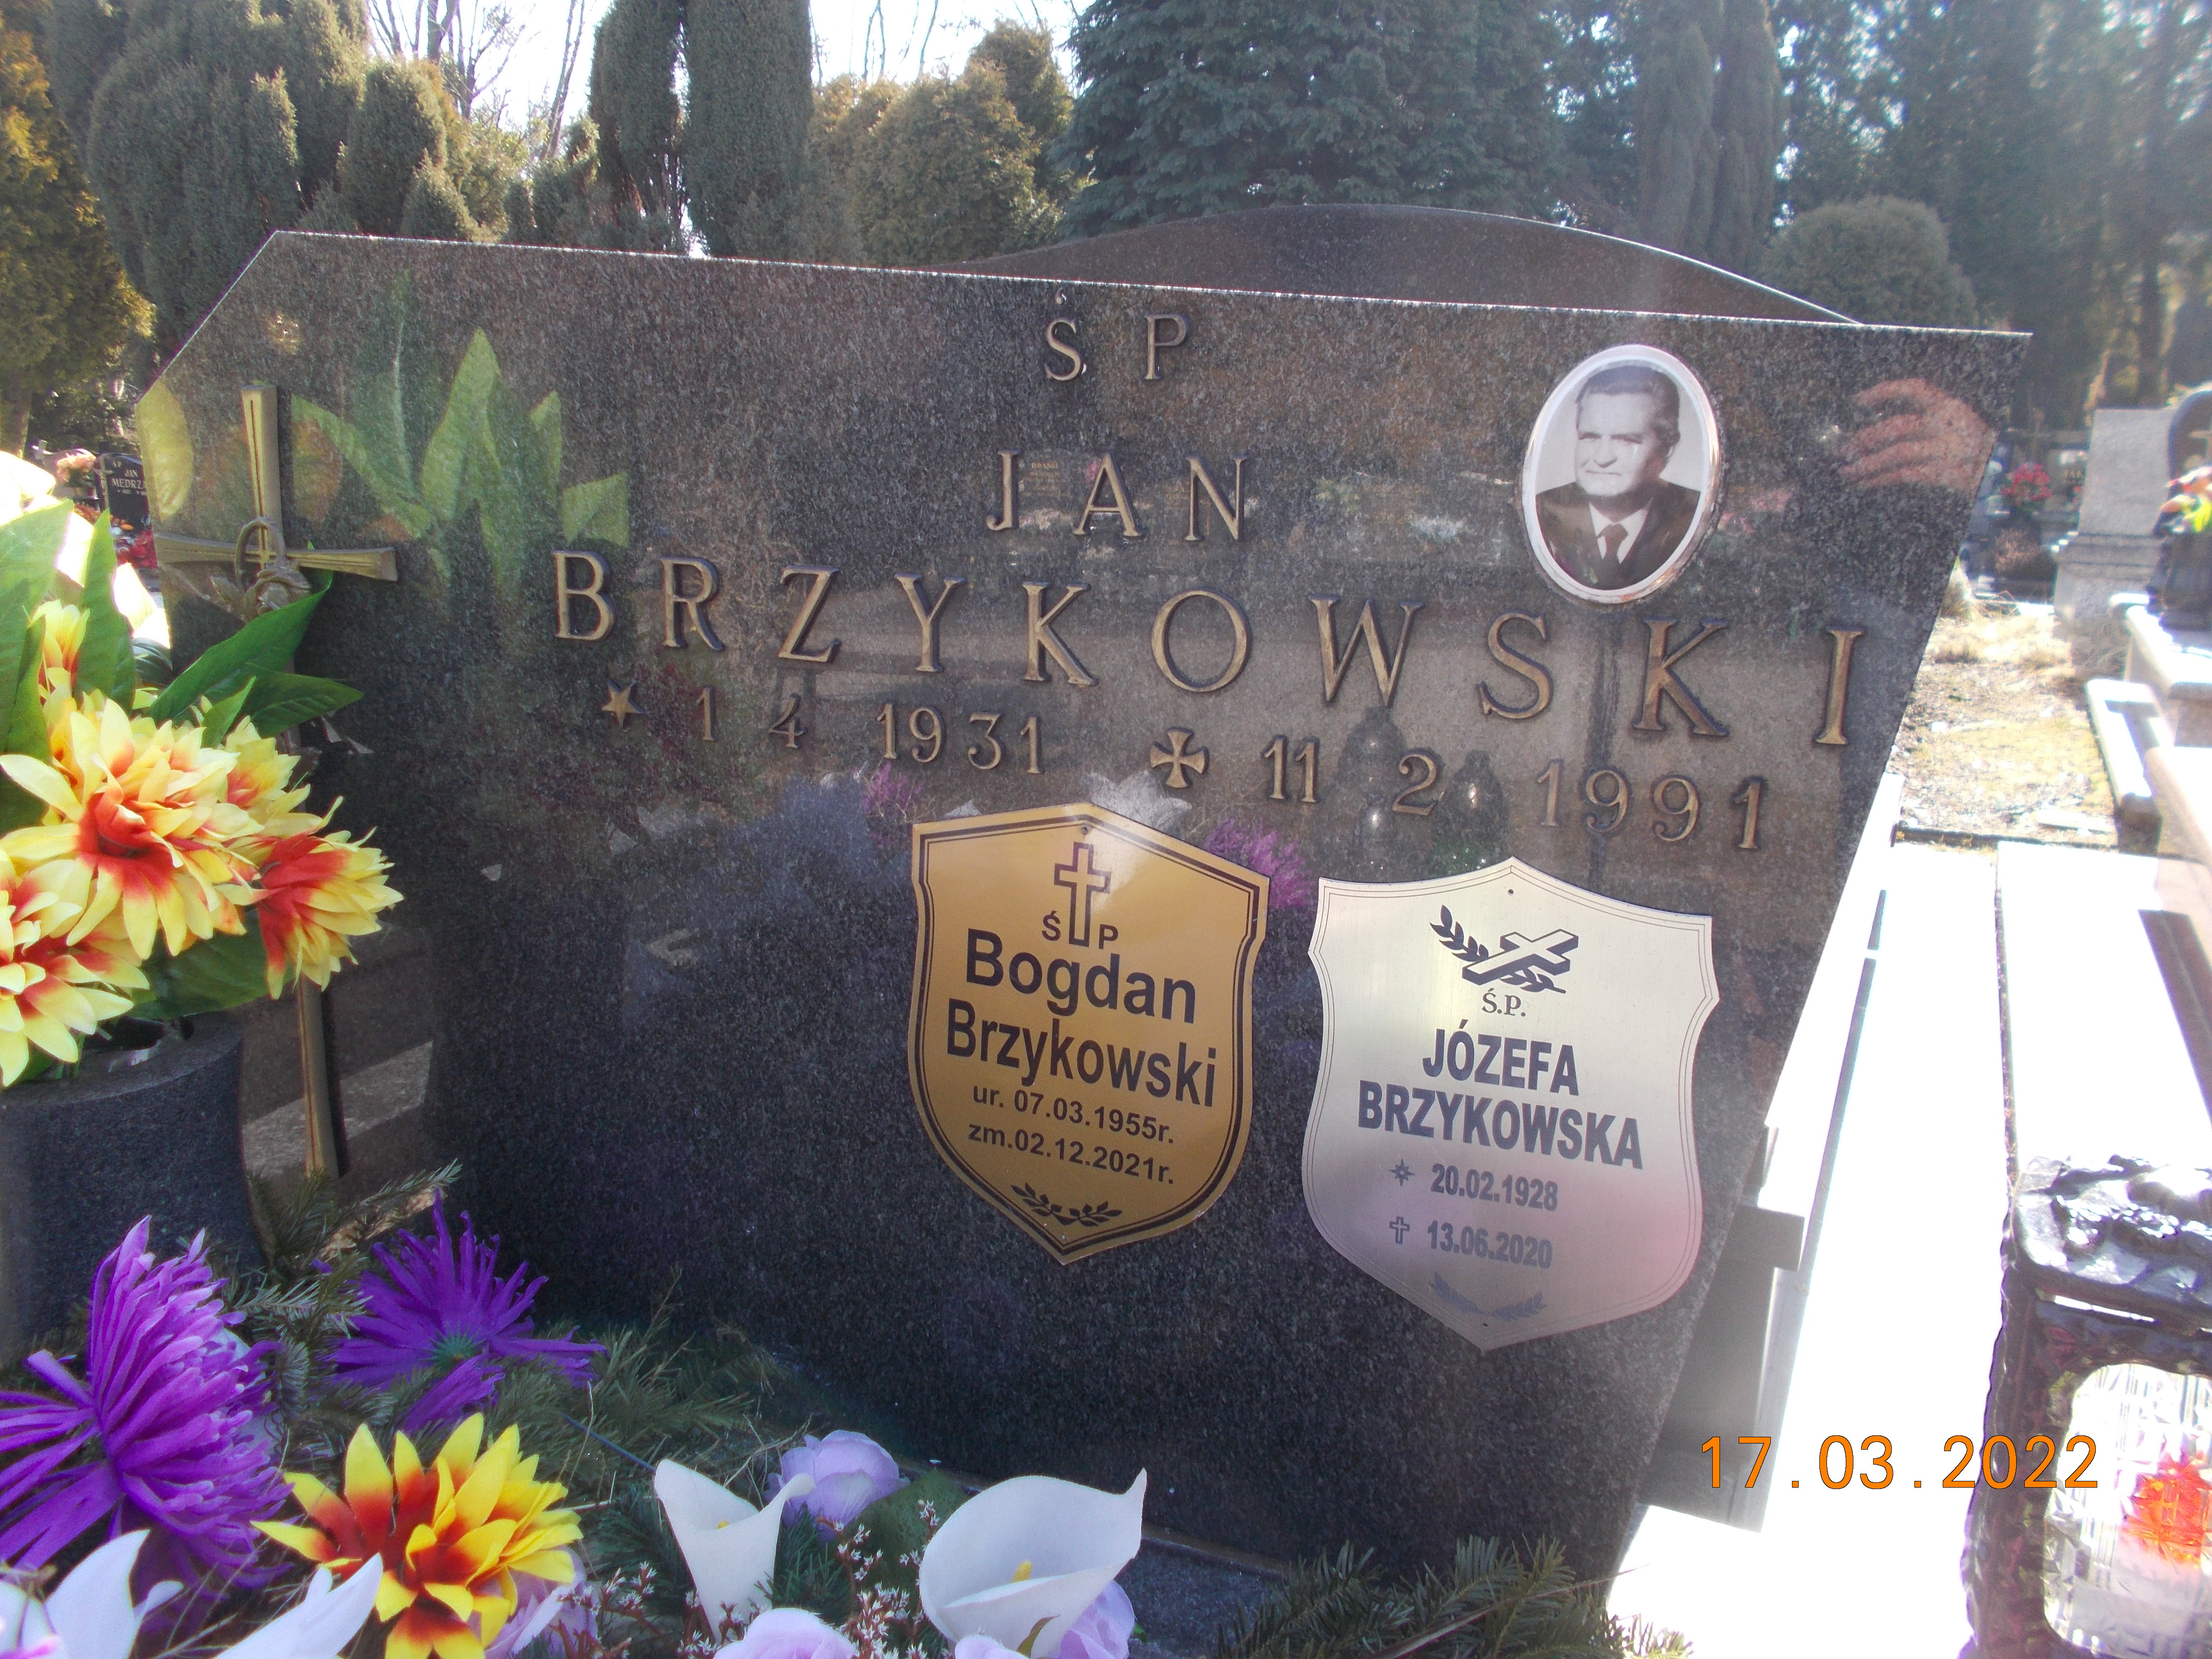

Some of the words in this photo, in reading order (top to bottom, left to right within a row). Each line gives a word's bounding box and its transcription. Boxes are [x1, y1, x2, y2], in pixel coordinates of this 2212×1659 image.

[1143, 313, 1189, 380] P
[986, 449, 1248, 541] JAN
[551, 550, 1865, 746] BRZYKOWSKI
[696, 685, 716, 742] 1
[770, 693, 808, 748] 4
[877, 703, 1045, 775] 1931
[1262, 734, 1320, 805] 11
[1392, 751, 1439, 817] 2
[1537, 758, 1765, 851] 1991
[1041, 911, 1061, 941] Ś
[1099, 923, 1118, 950] P
[966, 927, 1197, 1024] Bogdan
[1481, 987, 1527, 1017] Ś.P.
[947, 998, 1216, 1107] Brzykowski
[1422, 1019, 1579, 1096] JÓZEFA
[973, 1085, 1004, 1107] ur.
[1013, 1089, 1174, 1144] 07.03.1955r.
[1358, 1080, 1643, 1169] BRZYKOWSKA
[968, 1123, 1174, 1185] zm.02.12.2021r.
[1431, 1163, 1559, 1211] 20.02.1928
[1427, 1220, 1553, 1269] 13.06.2020
